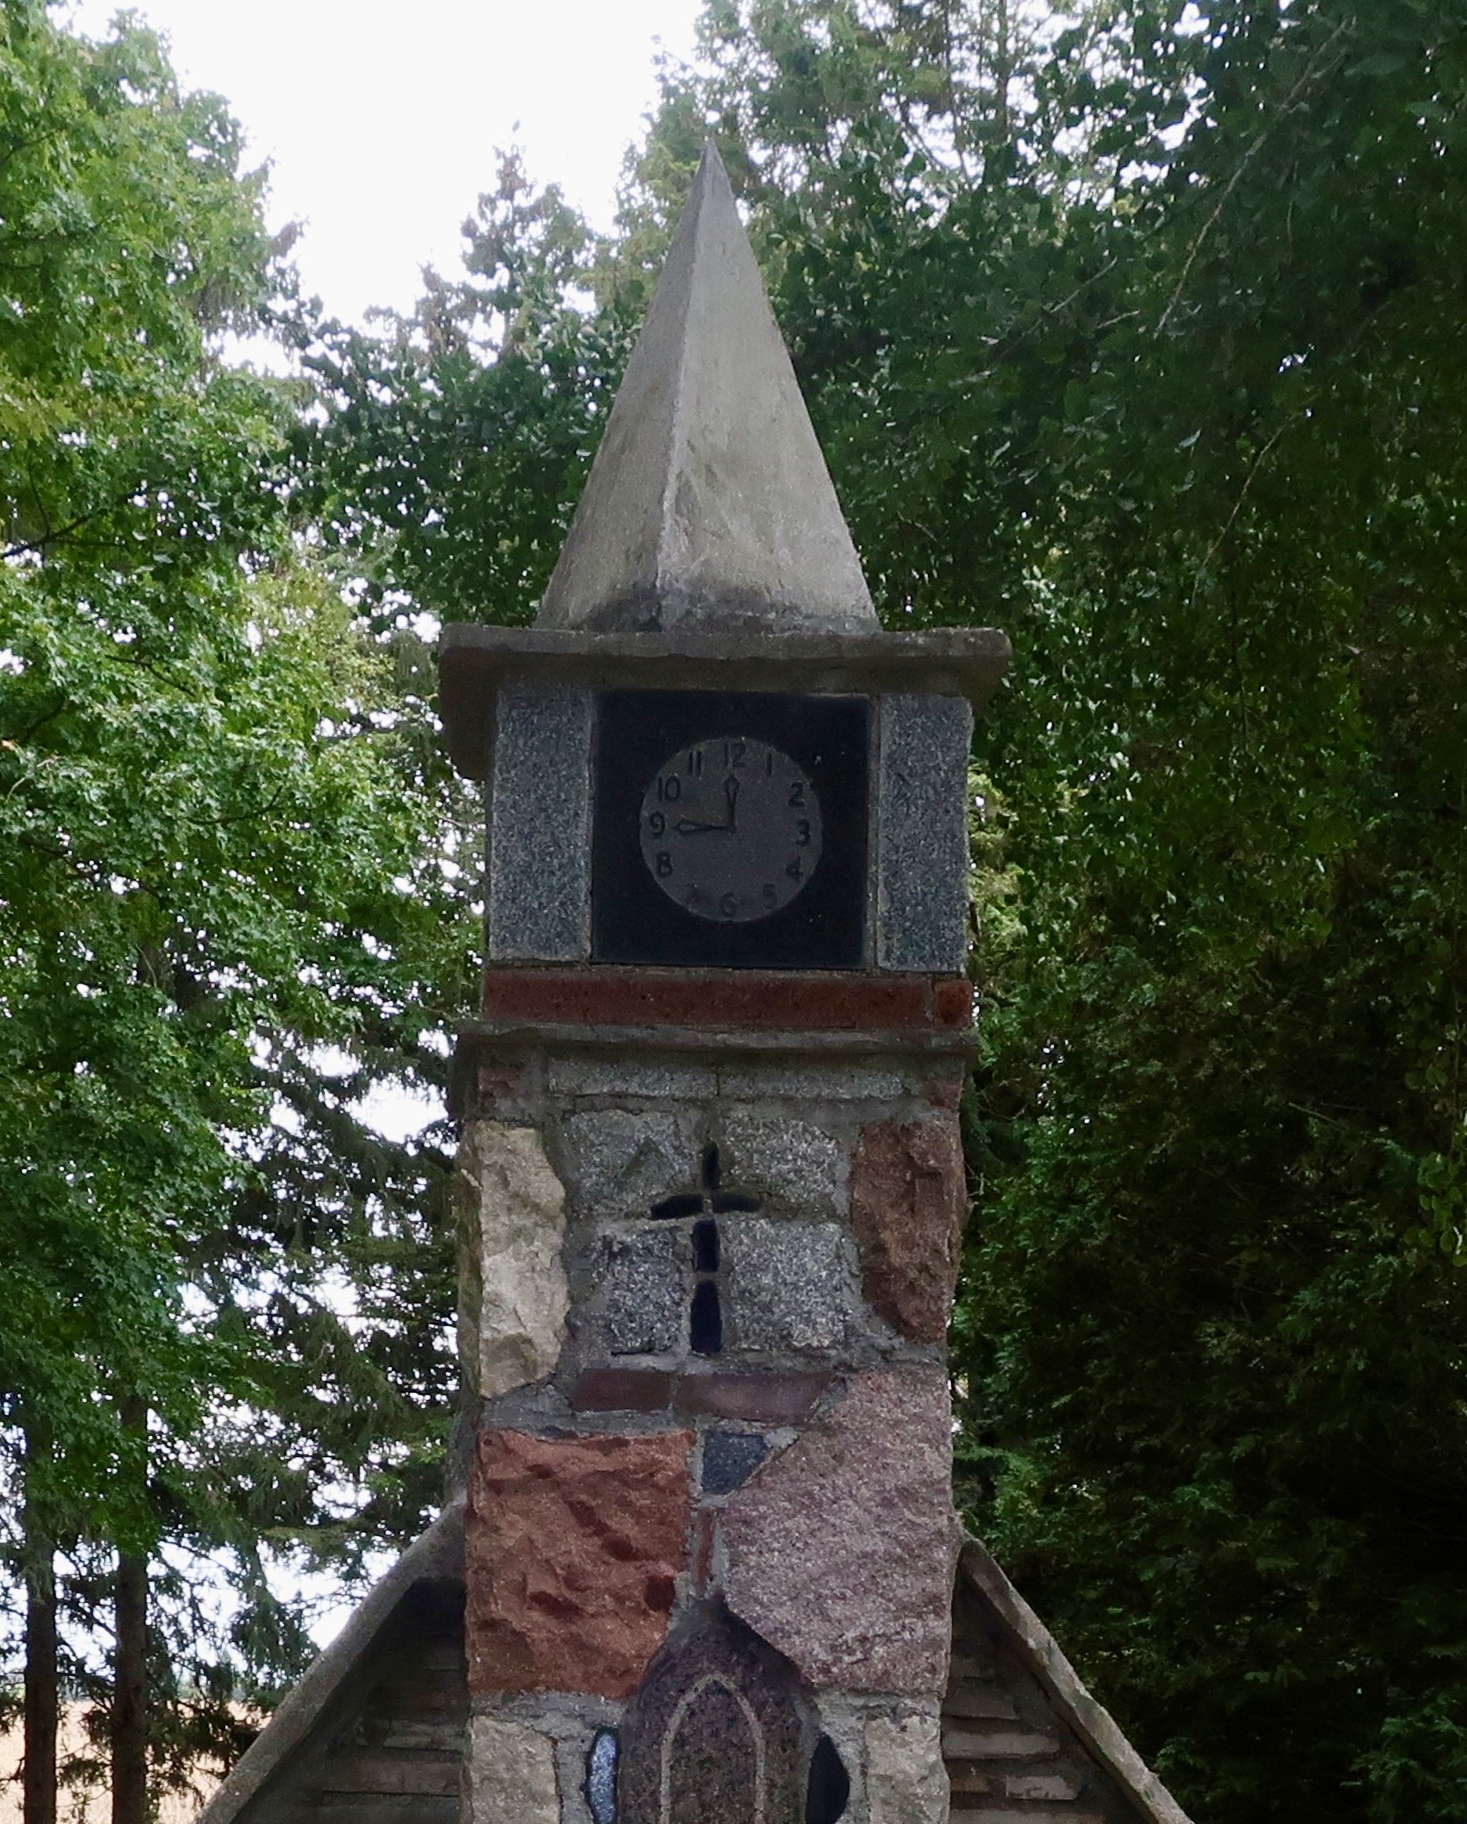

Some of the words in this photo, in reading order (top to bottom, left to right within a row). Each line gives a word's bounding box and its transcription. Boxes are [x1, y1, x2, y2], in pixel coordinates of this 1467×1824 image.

[658, 775, 681, 801] 10
[788, 781, 805, 808] 2
[649, 810, 666, 838] 9
[795, 818, 811, 846] 3
[656, 851, 673, 878] 8
